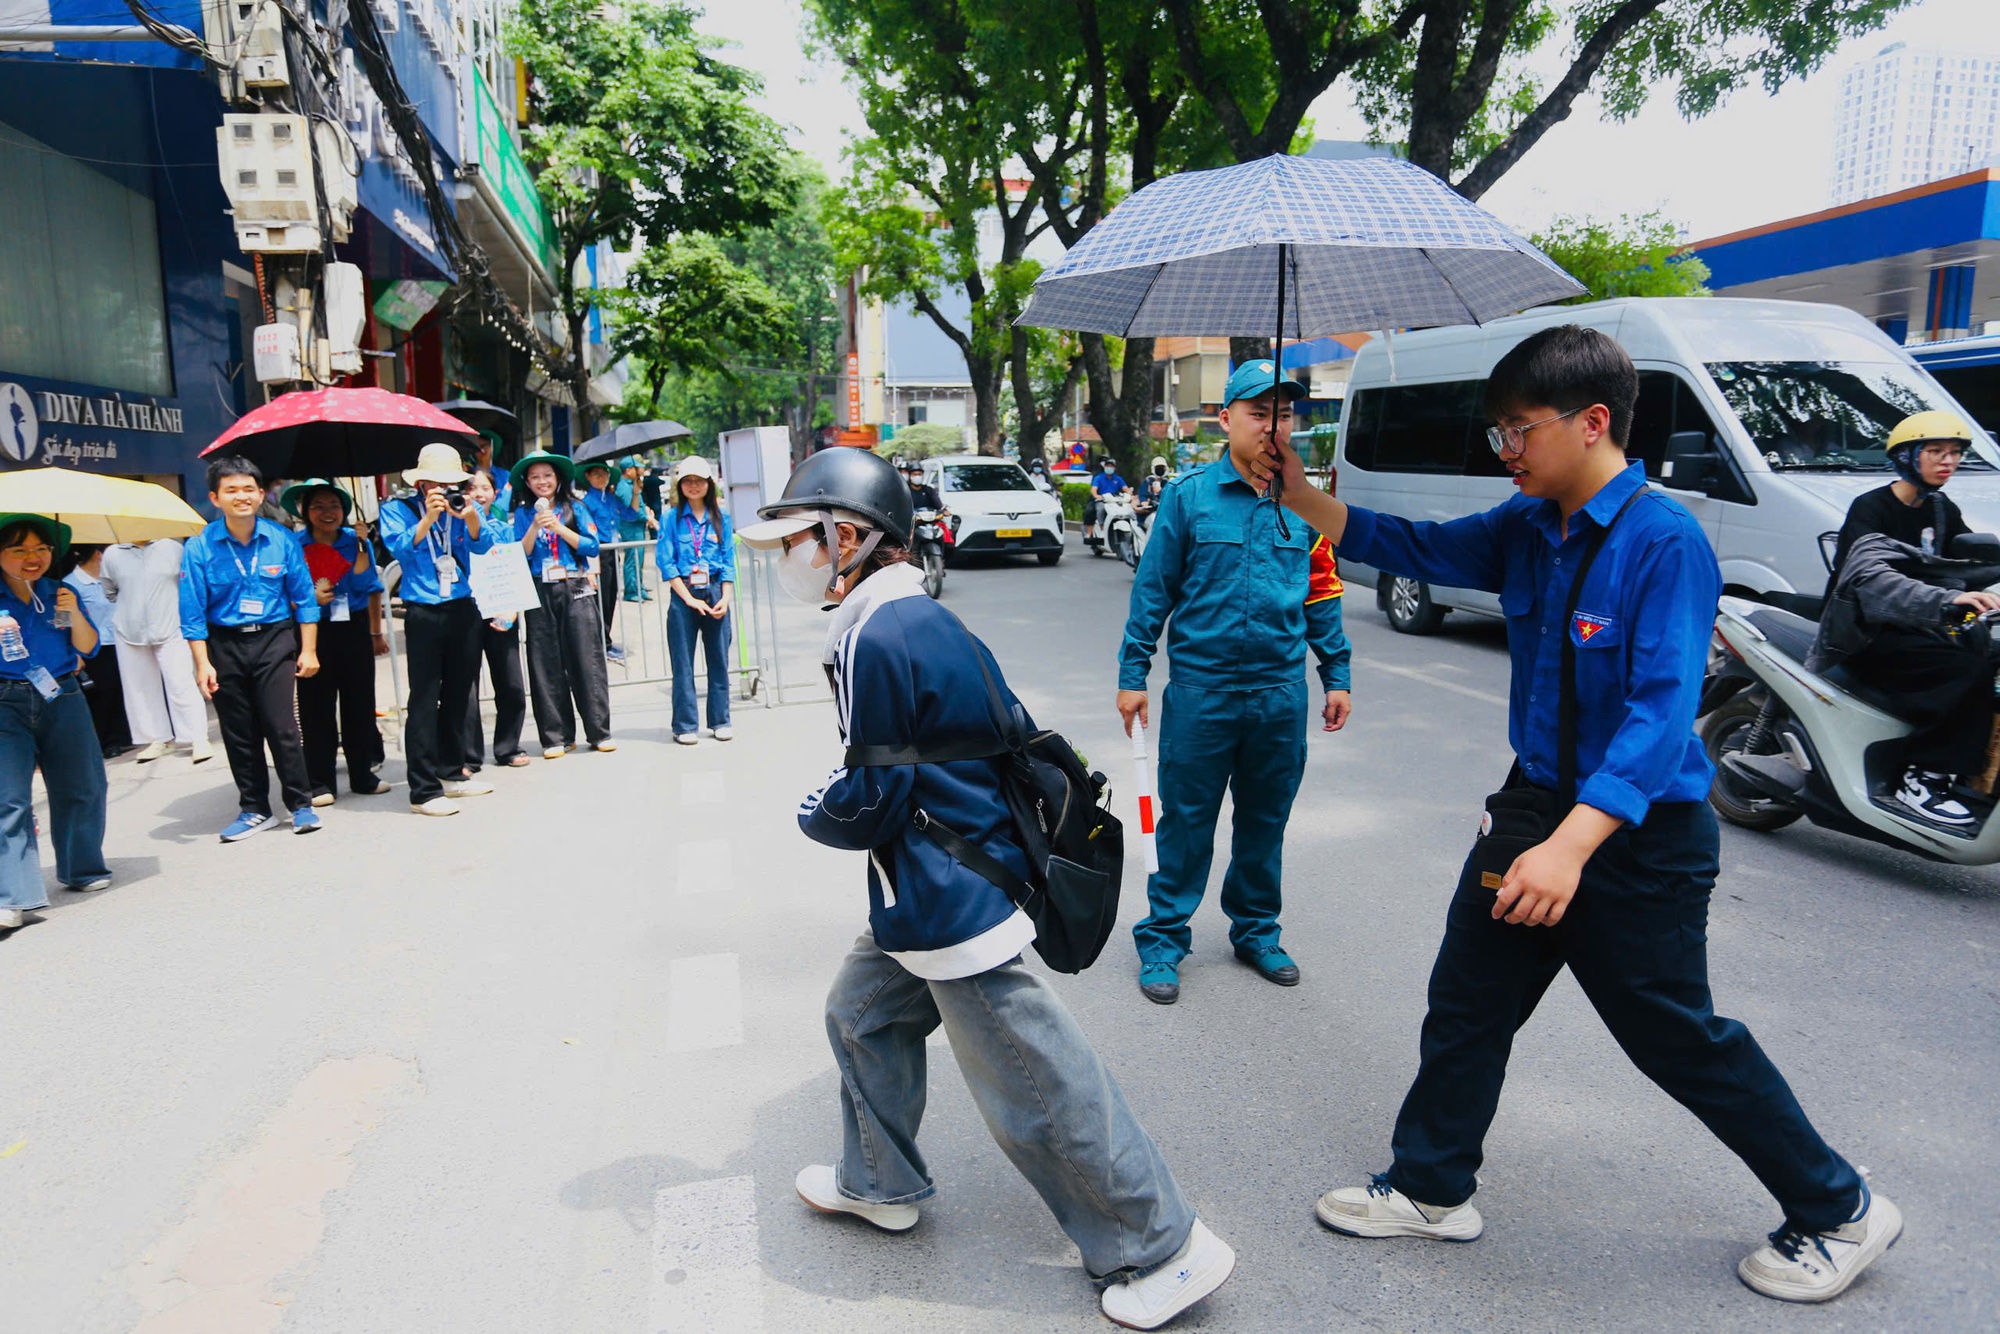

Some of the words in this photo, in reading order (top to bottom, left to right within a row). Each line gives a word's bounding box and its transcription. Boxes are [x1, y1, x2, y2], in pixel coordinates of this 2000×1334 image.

[43, 392, 98, 426] DIVA
[100, 392, 130, 428] HÀ
[127, 398, 184, 433] THÀNH
